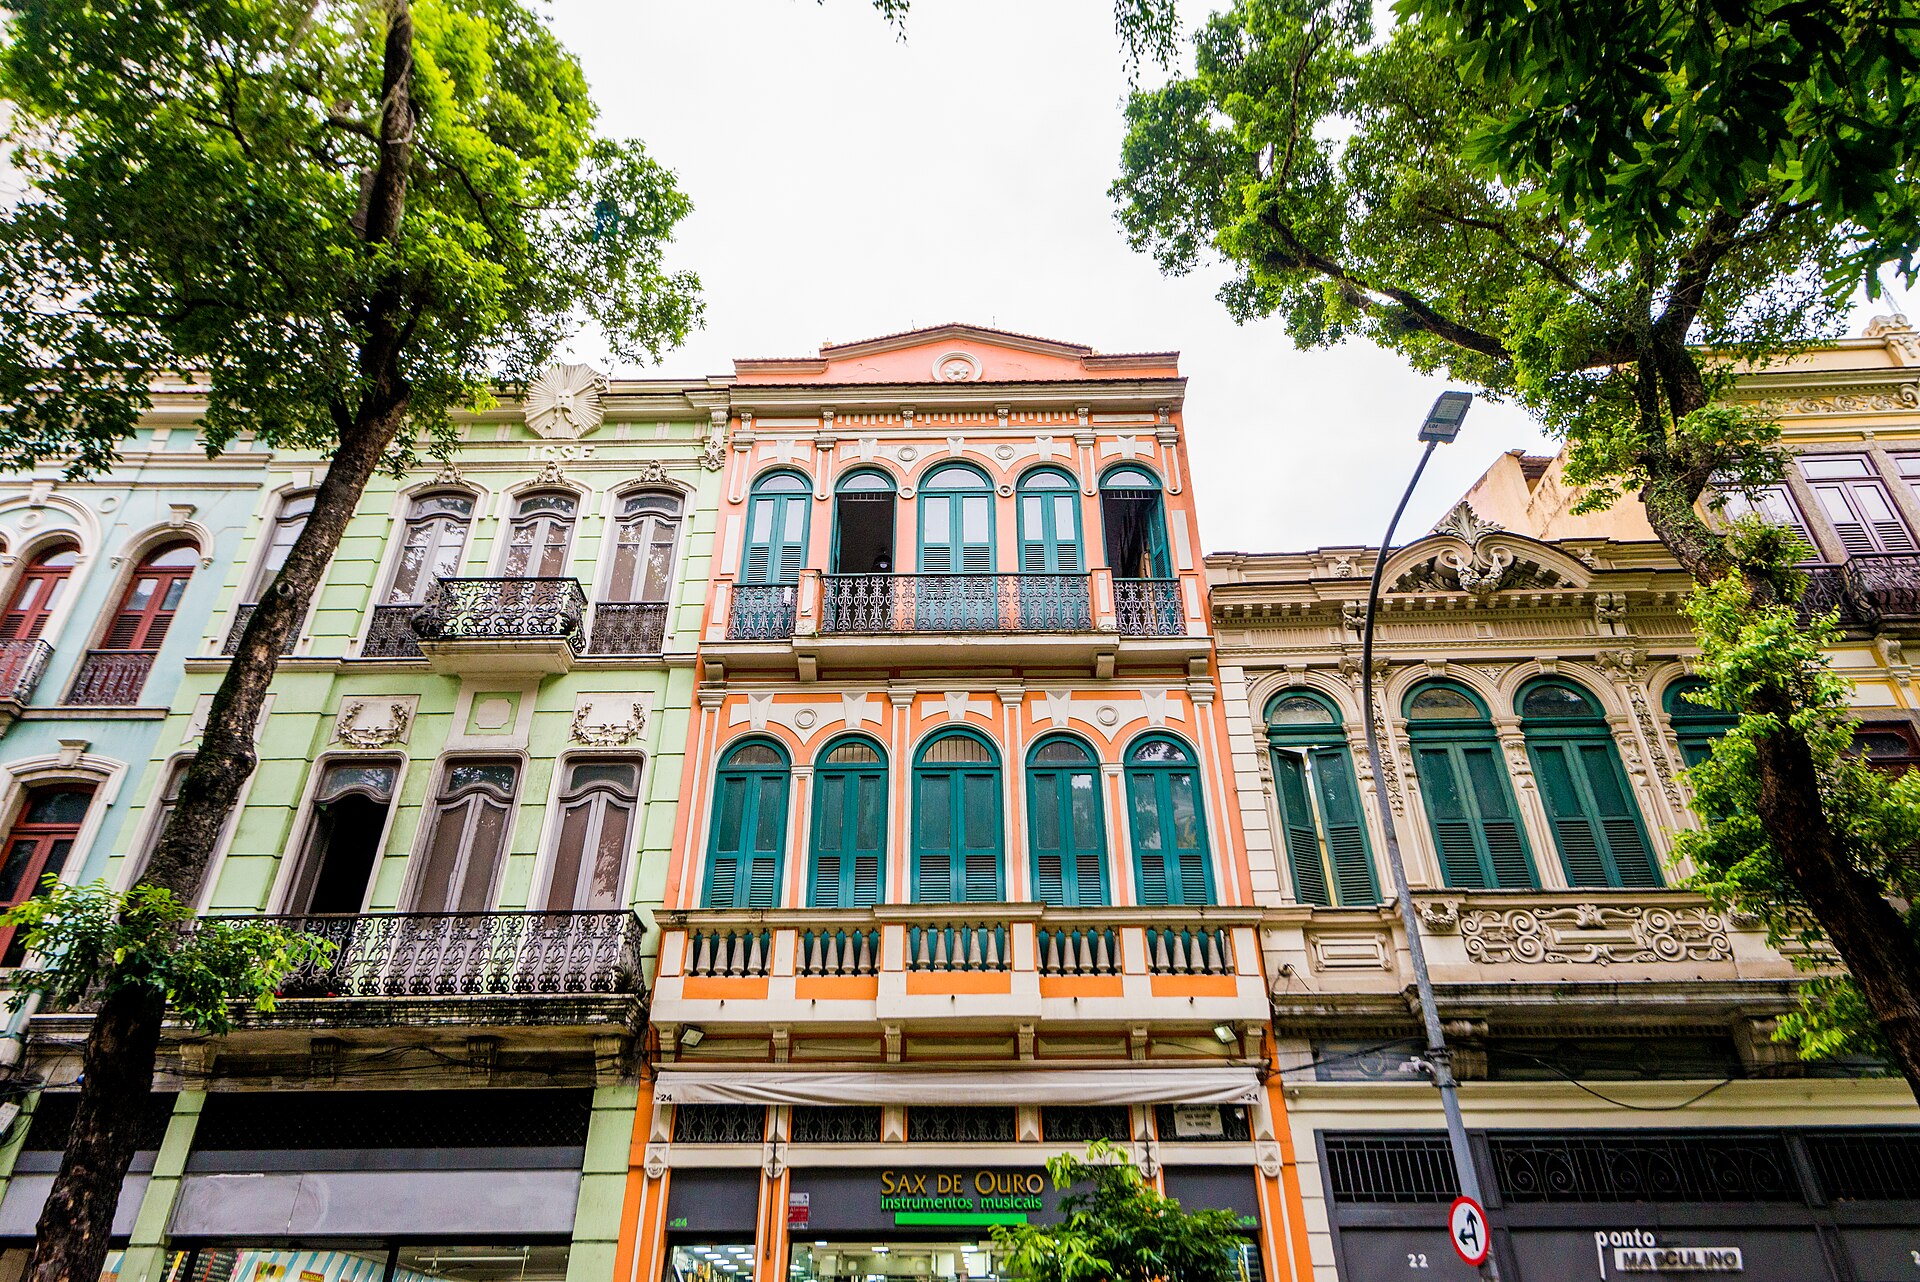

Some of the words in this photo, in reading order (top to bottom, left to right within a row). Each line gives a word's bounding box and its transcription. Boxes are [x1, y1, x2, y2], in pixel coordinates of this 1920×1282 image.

[881, 1171, 927, 1194] SAX
[937, 1174, 964, 1194] DE
[975, 1171, 1044, 1194] OURO
[881, 1195, 973, 1210] instrumentos
[980, 1195, 1043, 1210] musicais
[1407, 1253, 1429, 1268] 22
[1594, 1228, 1656, 1280] ponto
[1623, 1251, 1737, 1268] MASCULINO
